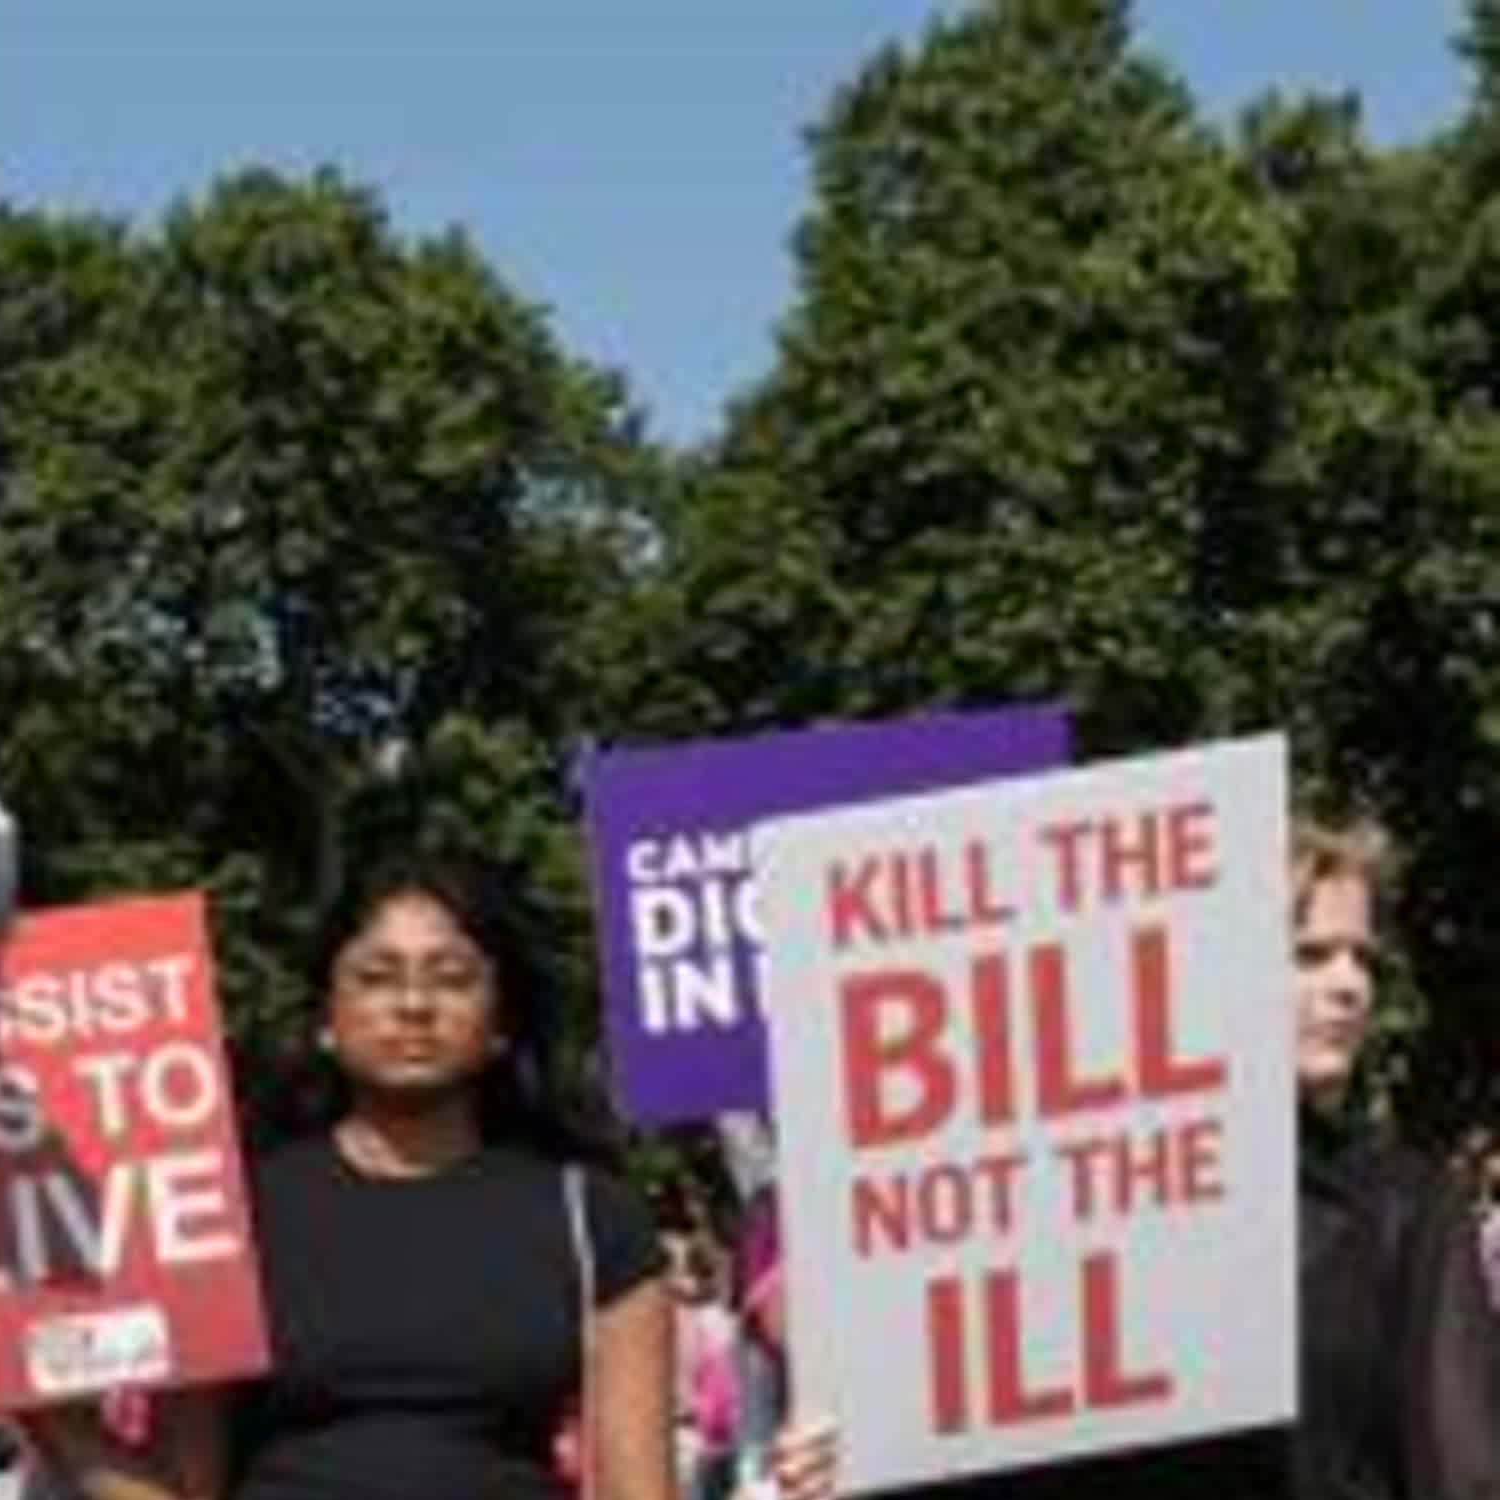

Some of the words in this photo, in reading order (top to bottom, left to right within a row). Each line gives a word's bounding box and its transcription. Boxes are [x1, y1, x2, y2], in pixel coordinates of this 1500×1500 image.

[825, 842, 1016, 947] KILL
[1037, 805, 1216, 911] THE
[74, 1041, 218, 1138] TO
[839, 926, 1227, 1150] BILL
[852, 1155, 1030, 1258] NOT
[1053, 1120, 1224, 1224] THE
[926, 1251, 1174, 1436] ILL
